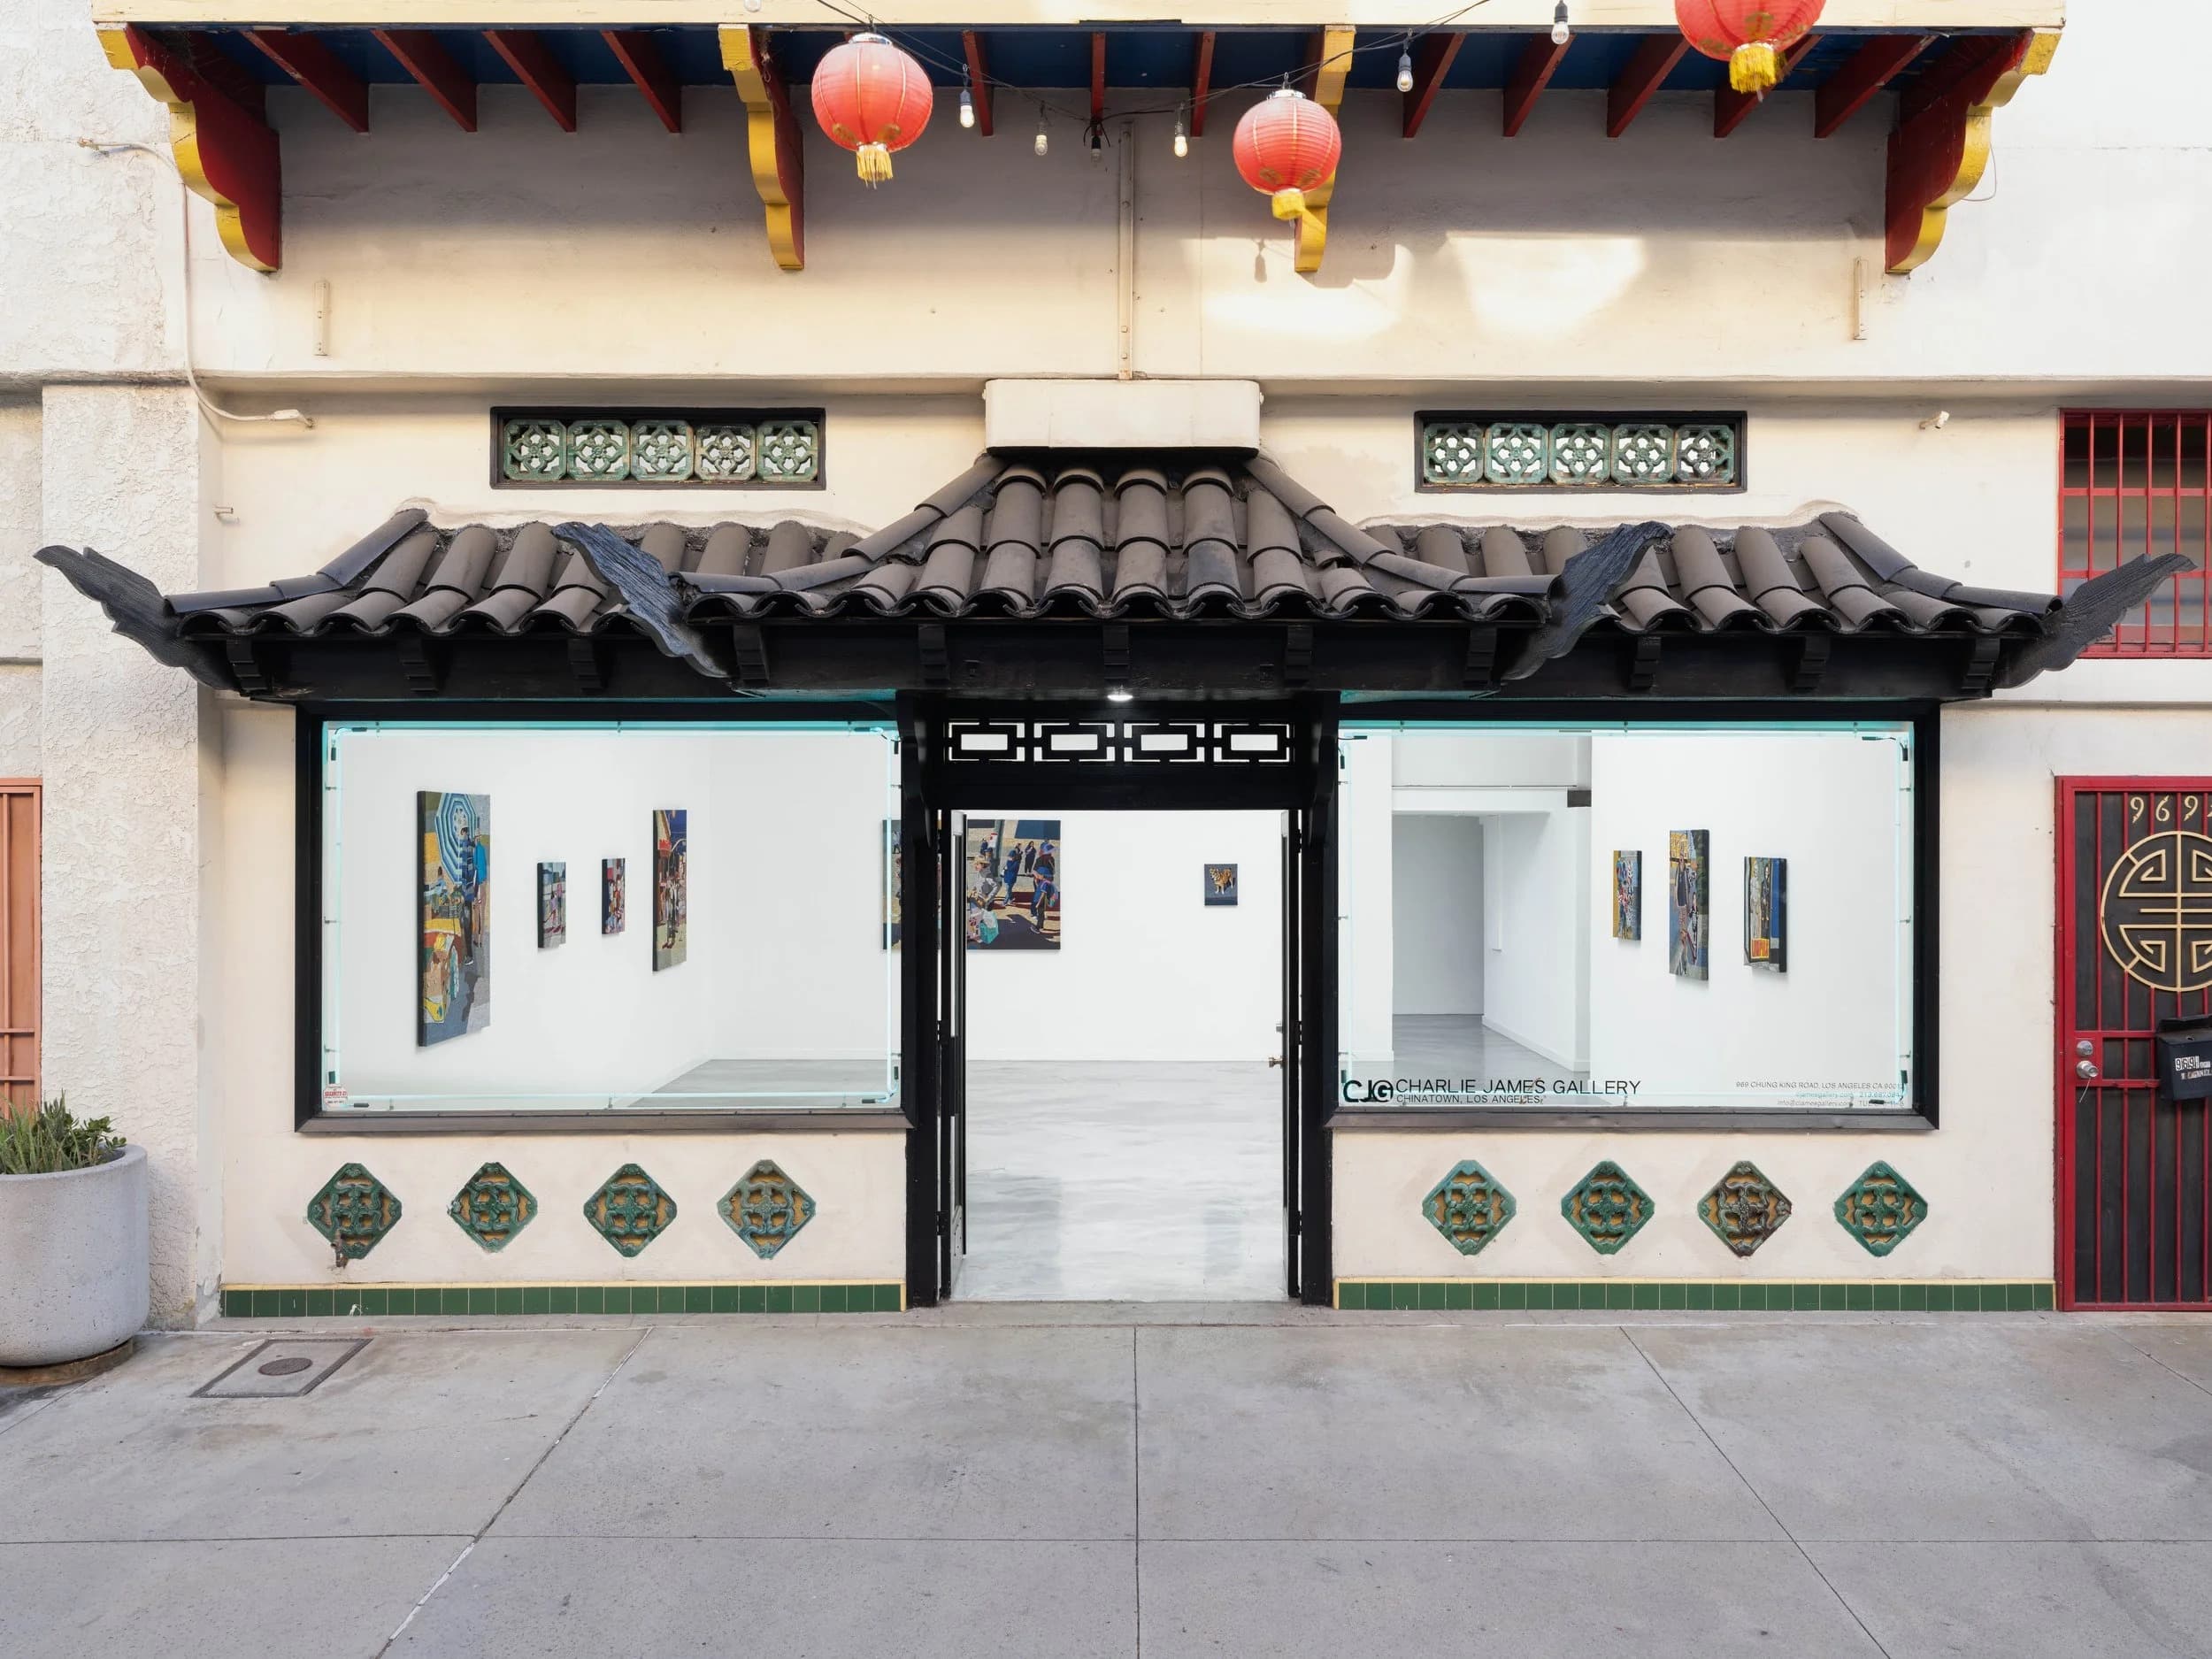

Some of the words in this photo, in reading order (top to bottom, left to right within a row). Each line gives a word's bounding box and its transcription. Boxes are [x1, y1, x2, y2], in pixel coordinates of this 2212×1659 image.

[2131, 795, 2212, 824] 969
[1395, 1079, 1477, 1094] CHARLIE
[1483, 1079, 1546, 1094] JAMES
[1553, 1079, 1641, 1094] GALLERY
[1396, 1094, 1463, 1104] CHINATOWN,
[1466, 1094, 1488, 1103] LOS
